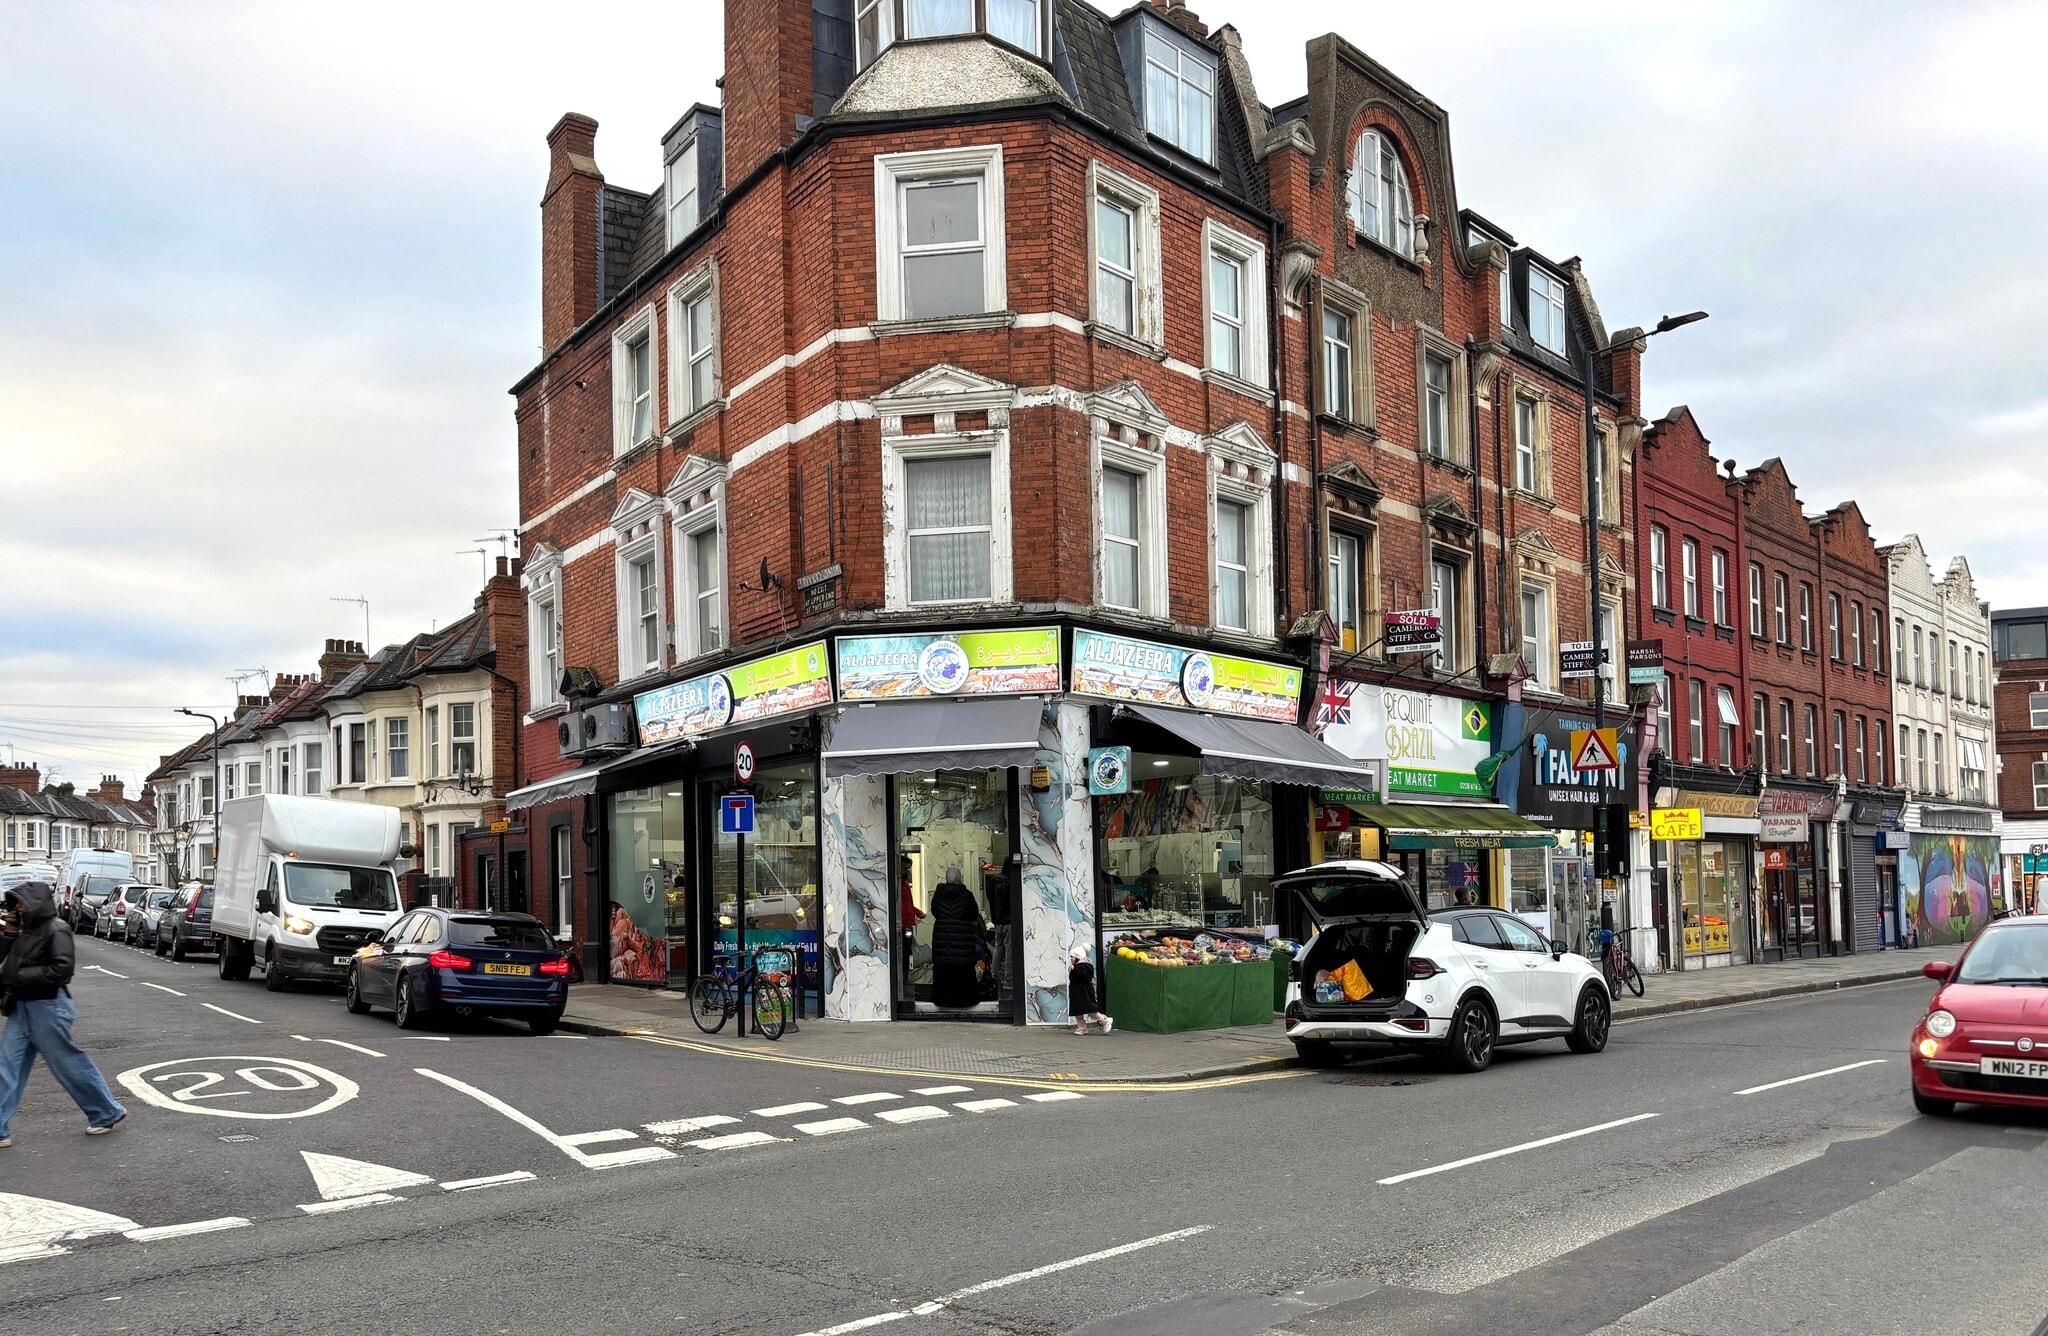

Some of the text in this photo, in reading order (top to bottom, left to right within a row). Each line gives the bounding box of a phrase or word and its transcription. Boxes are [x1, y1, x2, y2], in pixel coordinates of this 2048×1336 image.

[1398, 615, 1428, 626] SOLD
[1389, 634, 1413, 643] STIFF
[842, 653, 918, 668] ALJAZEERA
[1084, 638, 1174, 673] ALJAZEERA
[1563, 652, 1607, 661] CAMERS
[1563, 661, 1584, 669] STIFF
[647, 687, 704, 717] ALJAZEERA
[1558, 718, 1598, 731] TANNING SALO
[1385, 724, 1436, 761] BRAZIL
[738, 753, 752, 771] 20
[1388, 770, 1437, 788] EAT MARKET
[1324, 793, 1376, 801] MEAT MARKET
[1548, 790, 1569, 802] UNISEX
[1570, 791, 1583, 803] HAIR
[1584, 792, 1589, 803] &
[1772, 792, 1808, 814] VARANDA
[1696, 799, 1743, 814] KINGS CAFE
[1761, 818, 1802, 826] VARANDA
[1655, 824, 1699, 837] CAFE
[1455, 837, 1501, 848] FRESH MEAT
[489, 964, 526, 974] SN19 FEJ
[1992, 1061, 2025, 1075] WN12
[152, 1066, 320, 1101] 20
